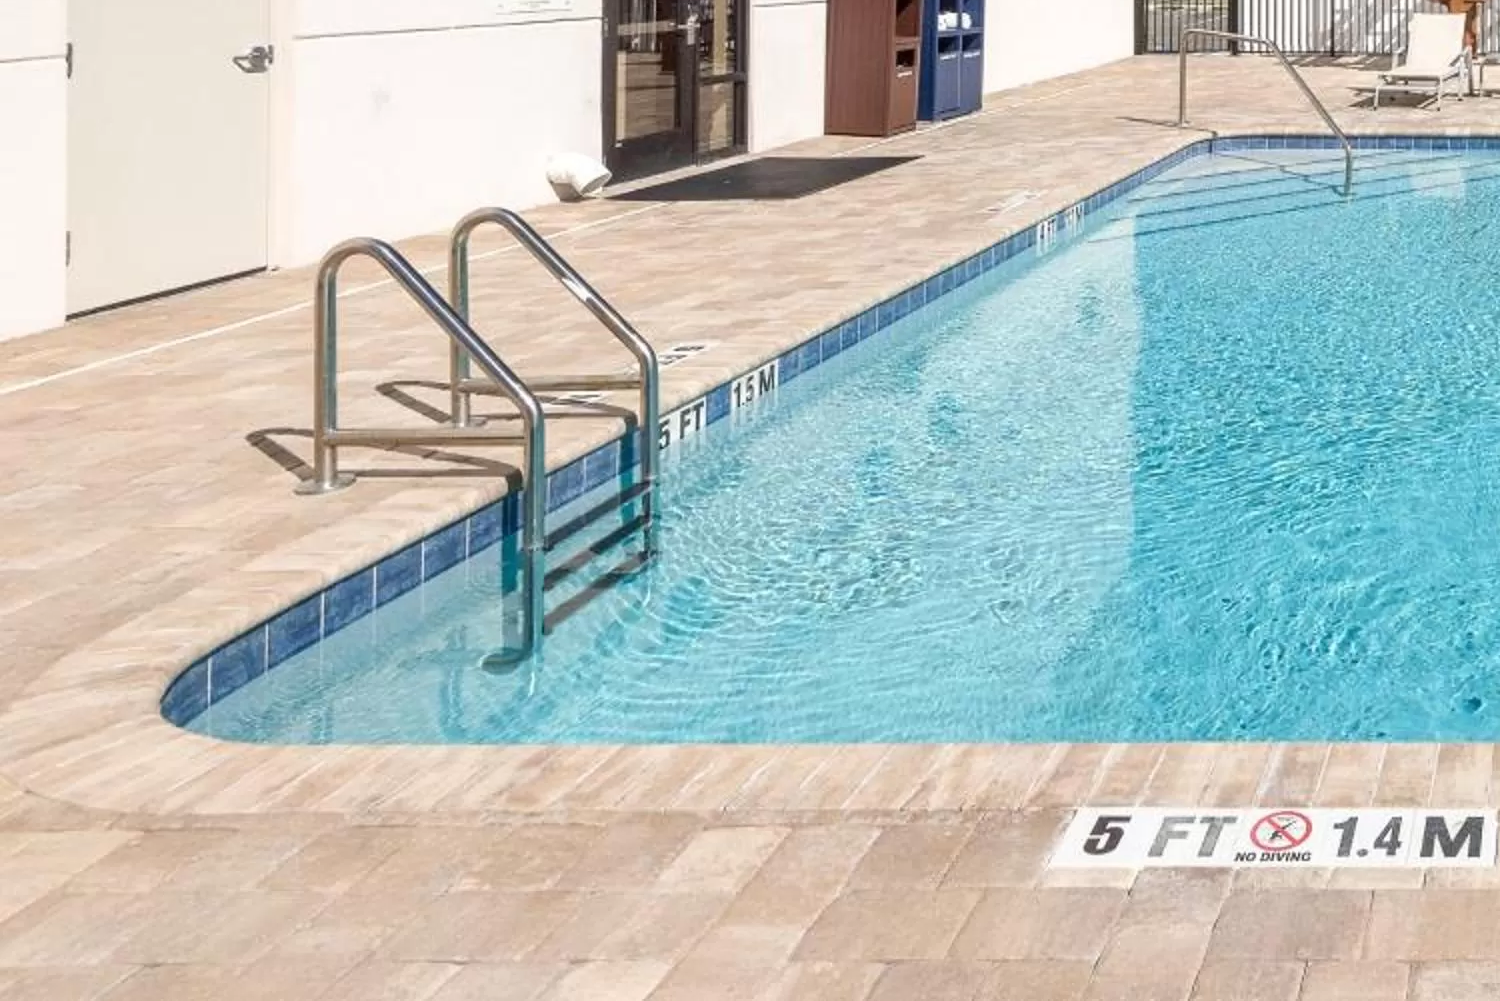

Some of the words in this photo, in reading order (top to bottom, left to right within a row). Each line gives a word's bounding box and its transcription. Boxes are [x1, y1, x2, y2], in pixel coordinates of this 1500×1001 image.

[733, 375, 755, 408] 1.5
[759, 363, 776, 396] M
[657, 417, 671, 450] 5
[679, 401, 705, 440] FT
[1083, 814, 1132, 856] 5
[1148, 816, 1238, 858] FT
[1333, 816, 1403, 858] 1.4
[1419, 816, 1485, 858] M
[1234, 852, 1257, 862] NO
[1260, 852, 1312, 862] DIVING
